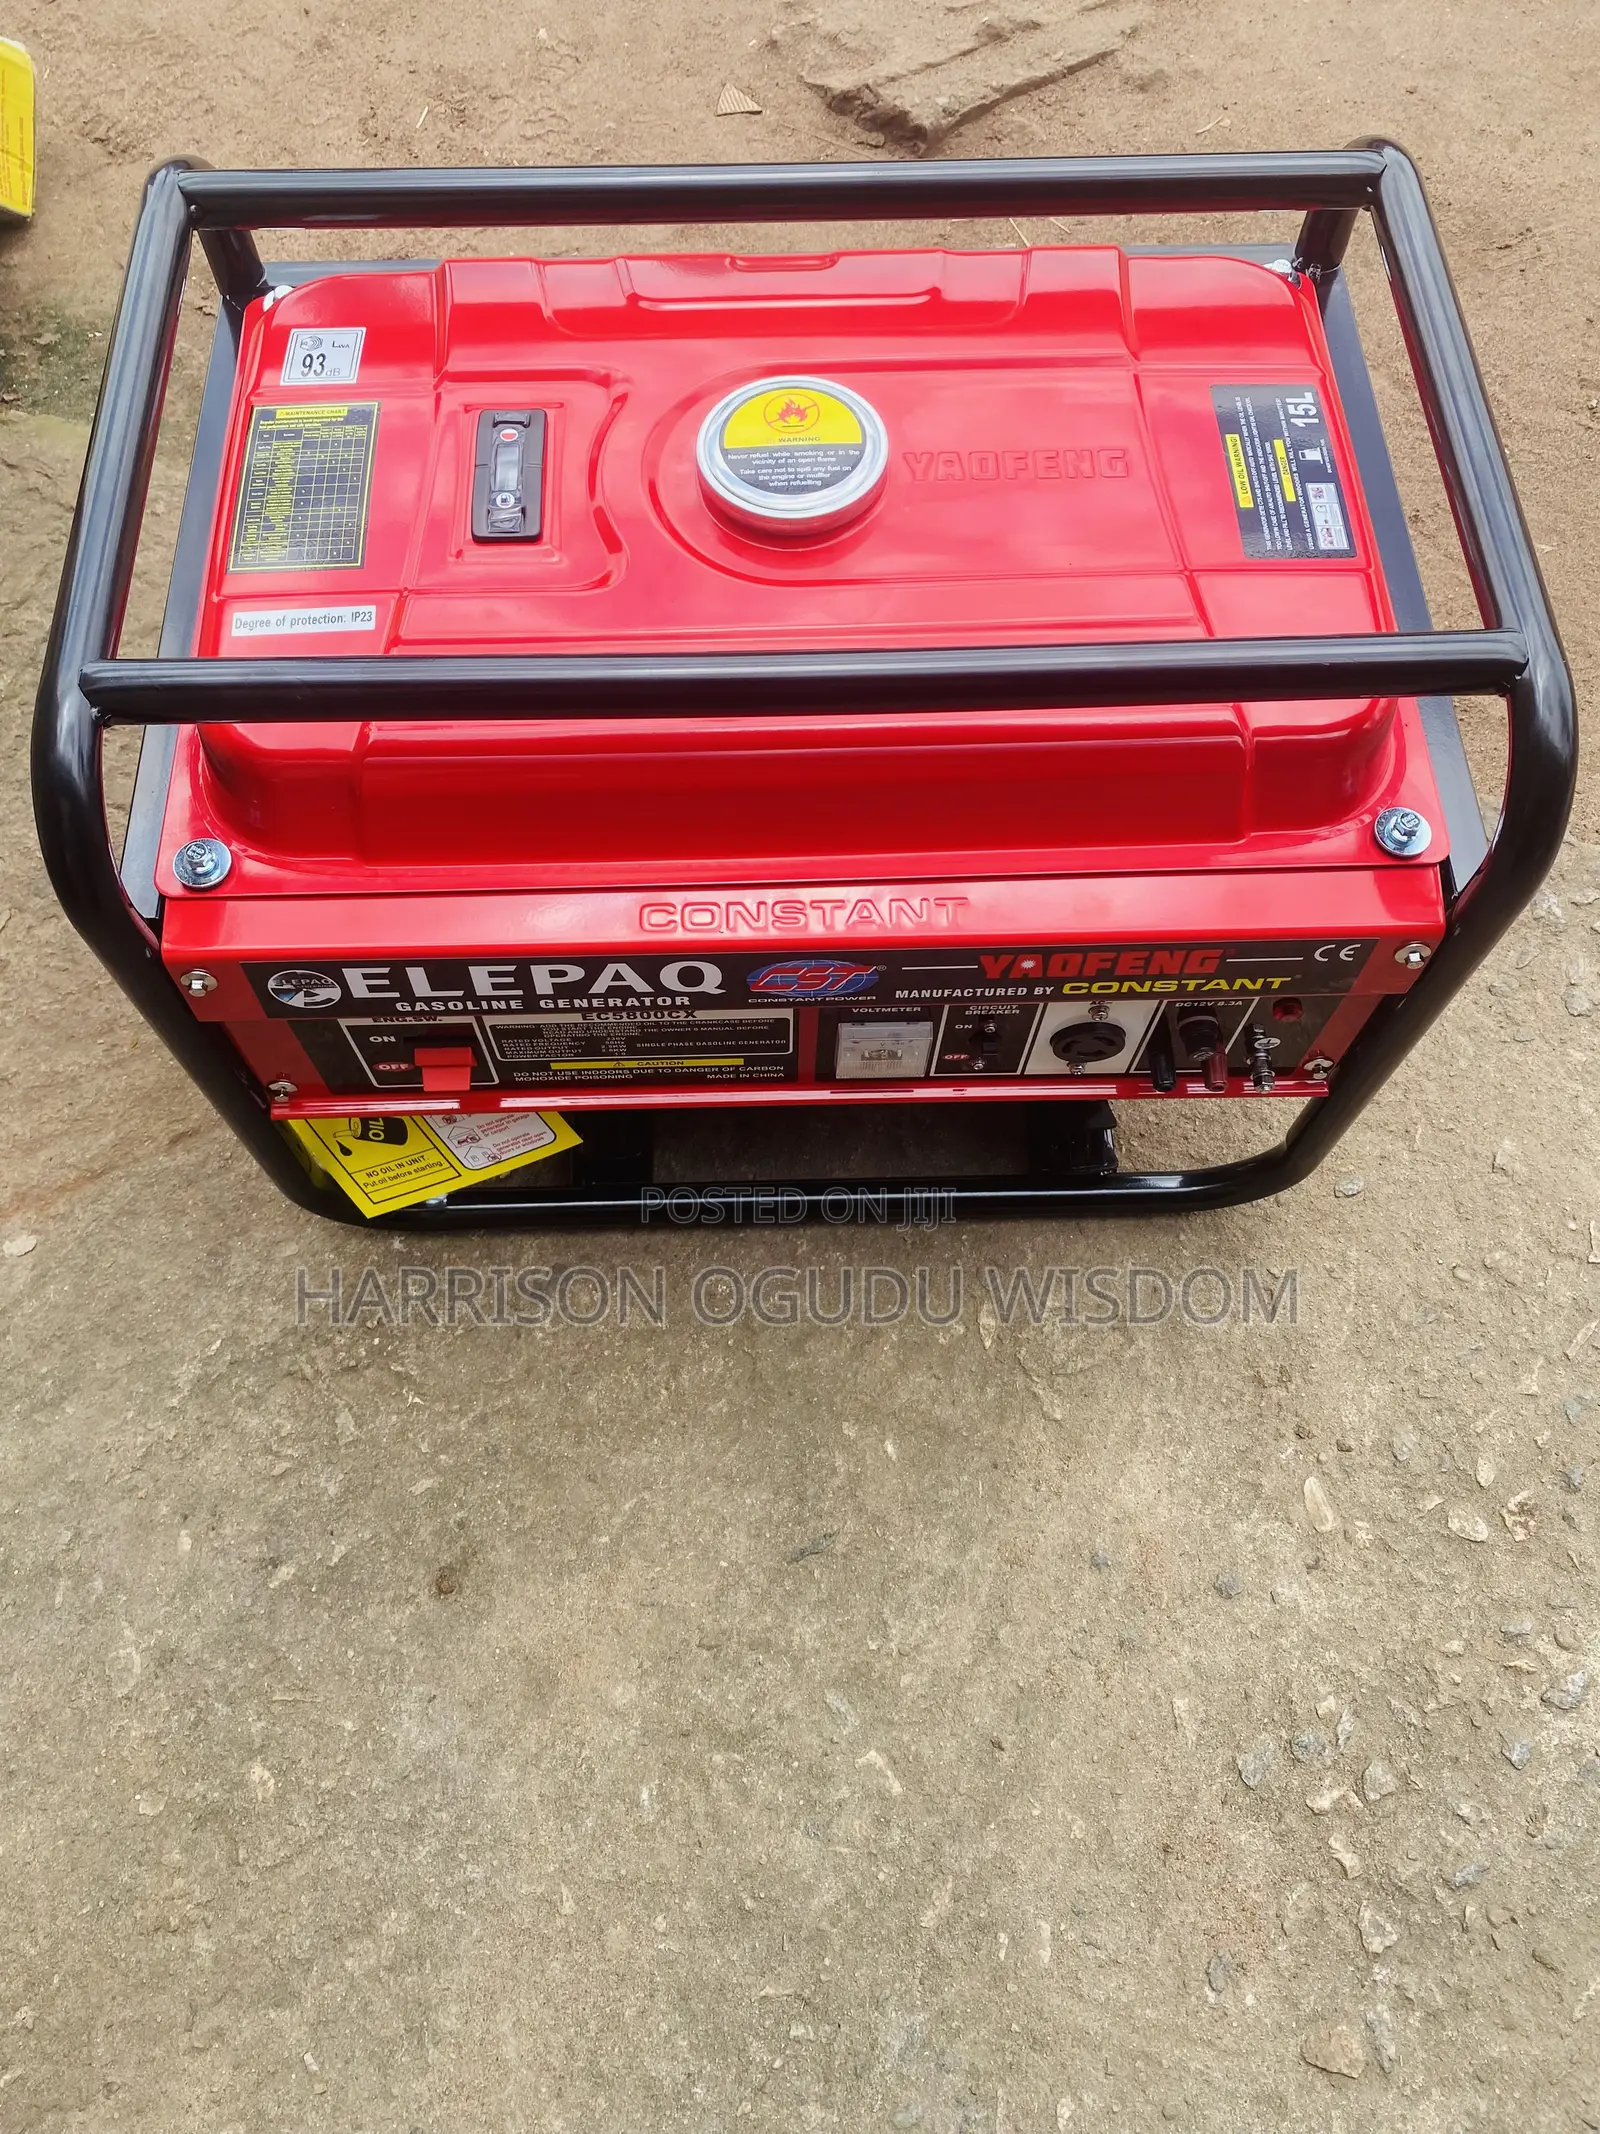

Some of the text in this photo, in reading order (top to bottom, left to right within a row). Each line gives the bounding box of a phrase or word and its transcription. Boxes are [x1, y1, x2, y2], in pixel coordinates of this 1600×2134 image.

[301, 353, 341, 377] 93 dB
[1285, 392, 1320, 427] 15L
[1230, 437, 1243, 467] WARNING!
[772, 473, 795, 481] engine
[902, 450, 1129, 482] YAOFENG
[1237, 469, 1245, 478] OIL
[1280, 457, 1289, 475] DANGER
[1239, 481, 1249, 494] LOW
[1298, 497, 1310, 528] GENERATOR
[235, 611, 373, 631] Degree of protection: IP23
[639, 896, 969, 934] CONSTANT
[980, 949, 1224, 979] YAOFENG
[342, 961, 726, 999] ELEPAQ
[895, 977, 1291, 999] MANUFACTURED BY CONSTANT
[395, 996, 691, 1012] GASOLINE GENERATOR
[748, 996, 823, 1004] CONSTANT
[581, 1009, 698, 1022] EC5800CX
[368, 1118, 385, 1140] OIL
[365, 1155, 430, 1179] NO OIL IN UNIT.
[378, 1176, 389, 1185] oil
[388, 1170, 413, 1182] before
[413, 1160, 445, 1174] starting.
